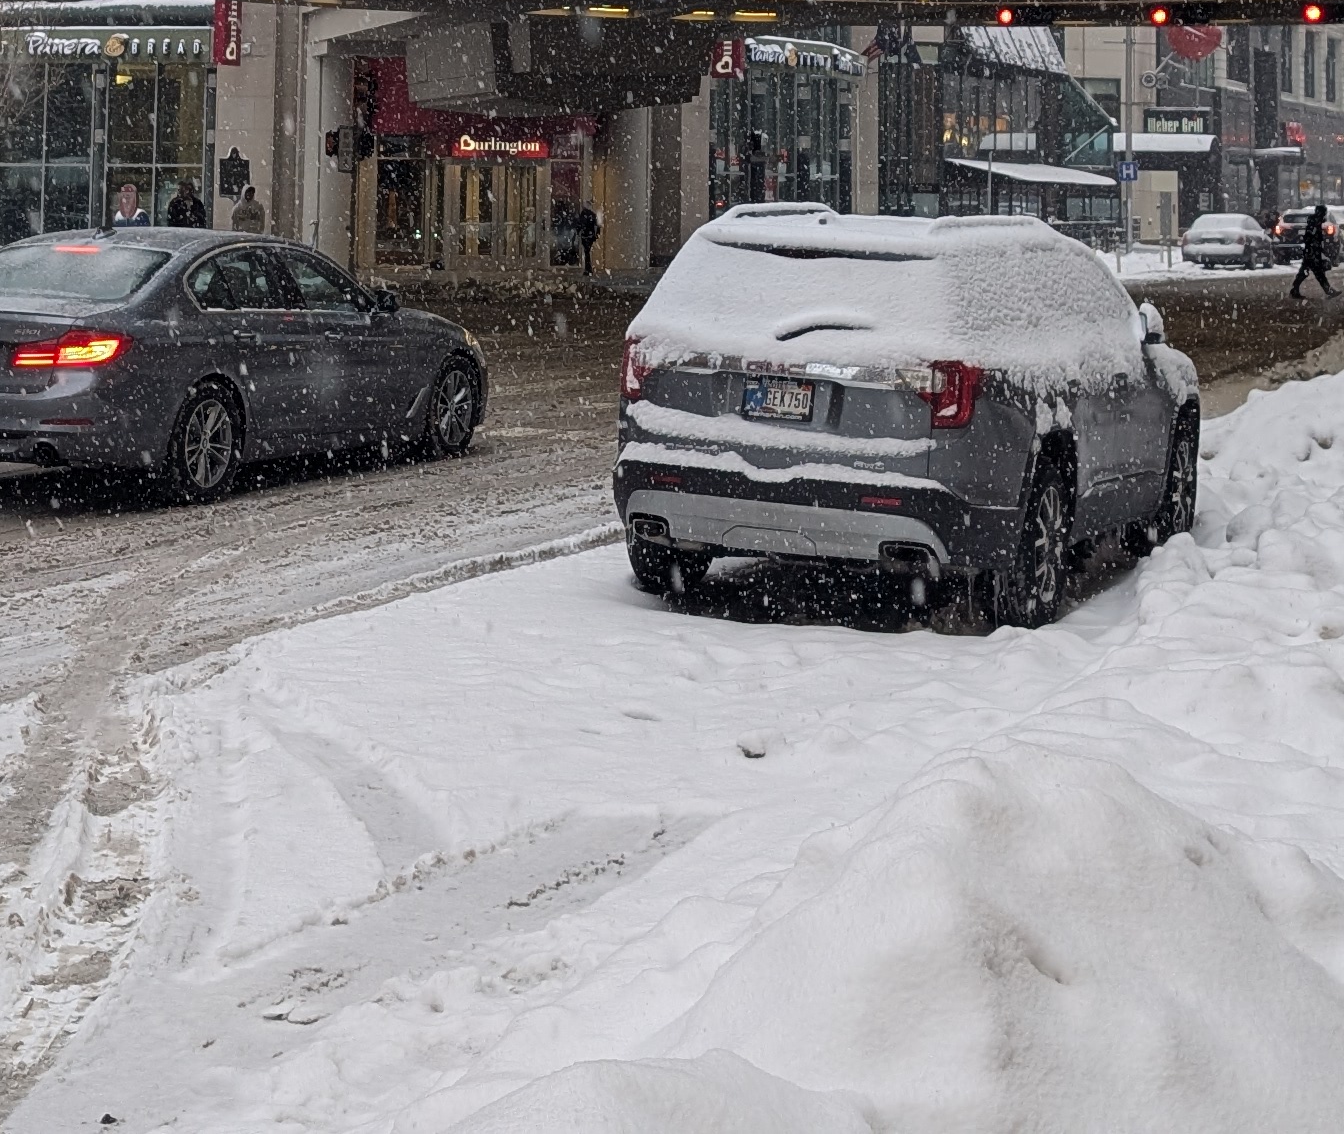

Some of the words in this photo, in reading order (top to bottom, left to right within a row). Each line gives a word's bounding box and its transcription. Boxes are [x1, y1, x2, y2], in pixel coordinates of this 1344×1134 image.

[25, 34, 101, 56] Panera
[131, 39, 203, 56] BREAD
[1147, 118, 1179, 133] Weber
[1182, 117, 1203, 133] Grill
[460, 134, 540, 155] Burlington
[1122, 164, 1135, 179] H
[765, 389, 809, 409] GEK750
